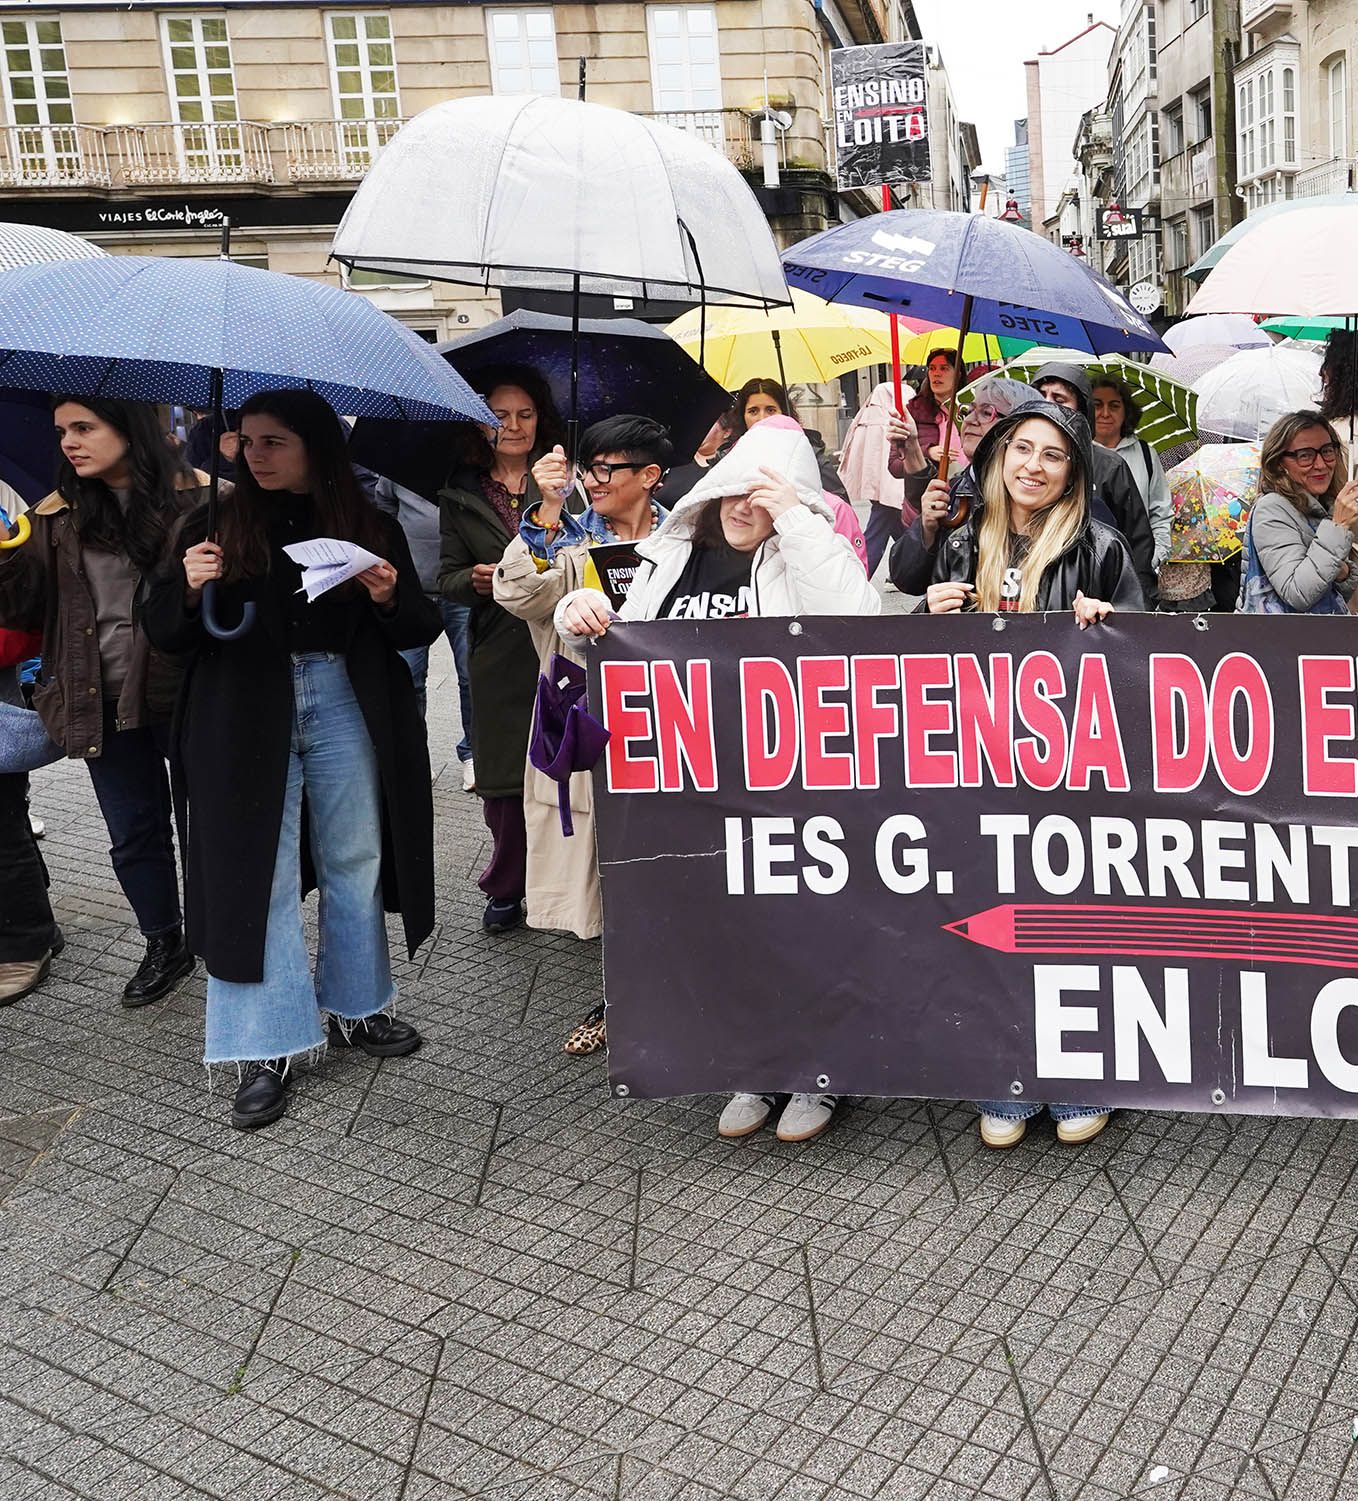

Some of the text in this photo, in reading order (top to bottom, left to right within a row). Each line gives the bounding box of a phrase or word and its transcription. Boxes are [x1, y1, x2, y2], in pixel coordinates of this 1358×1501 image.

[834, 78, 925, 111] ENSINO
[836, 110, 853, 123] EN
[837, 114, 925, 147] LOITA
[99, 205, 224, 225] VIAJES El Corte Inglés
[842, 251, 927, 273] STEG
[600, 658, 719, 793] EN
[739, 650, 1130, 792] DEFENSA
[1149, 652, 1275, 796] DO
[724, 815, 850, 895] IES
[875, 814, 954, 895] G.
[1033, 965, 1192, 1083] EN
